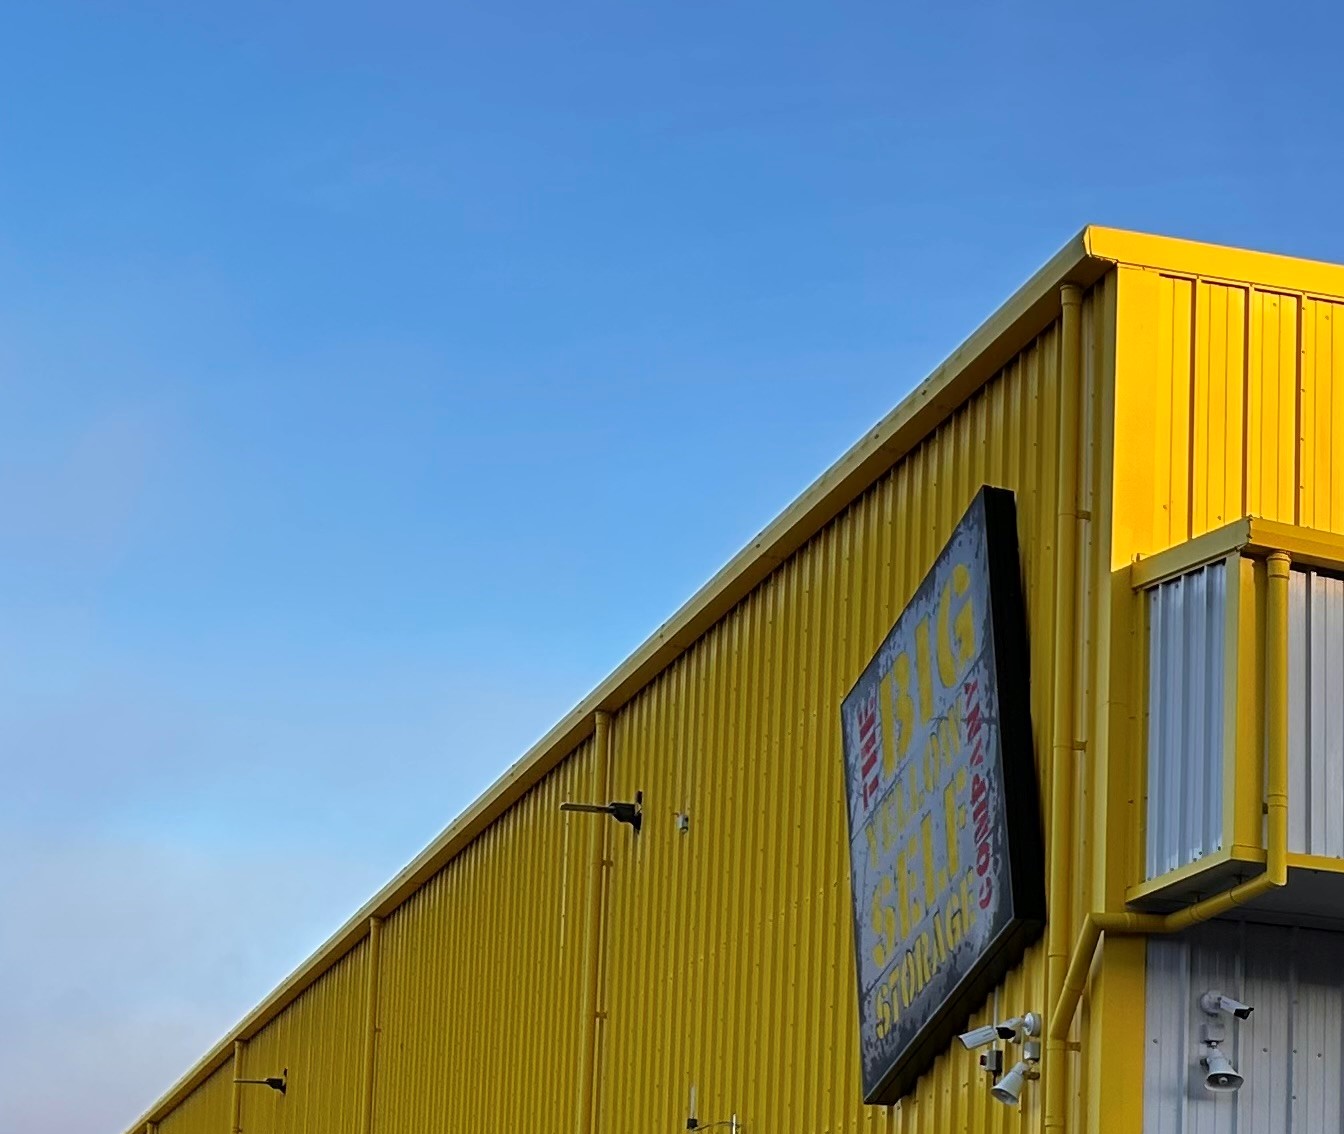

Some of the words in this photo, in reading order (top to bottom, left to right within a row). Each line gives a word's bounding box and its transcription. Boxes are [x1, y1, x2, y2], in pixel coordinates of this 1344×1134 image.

[857, 693, 880, 809] THE
[879, 564, 976, 781] BIG
[864, 693, 962, 869] YELLOW
[872, 766, 968, 966] SELF
[964, 679, 993, 909] COMPANY
[873, 862, 978, 1041] STORAGE
